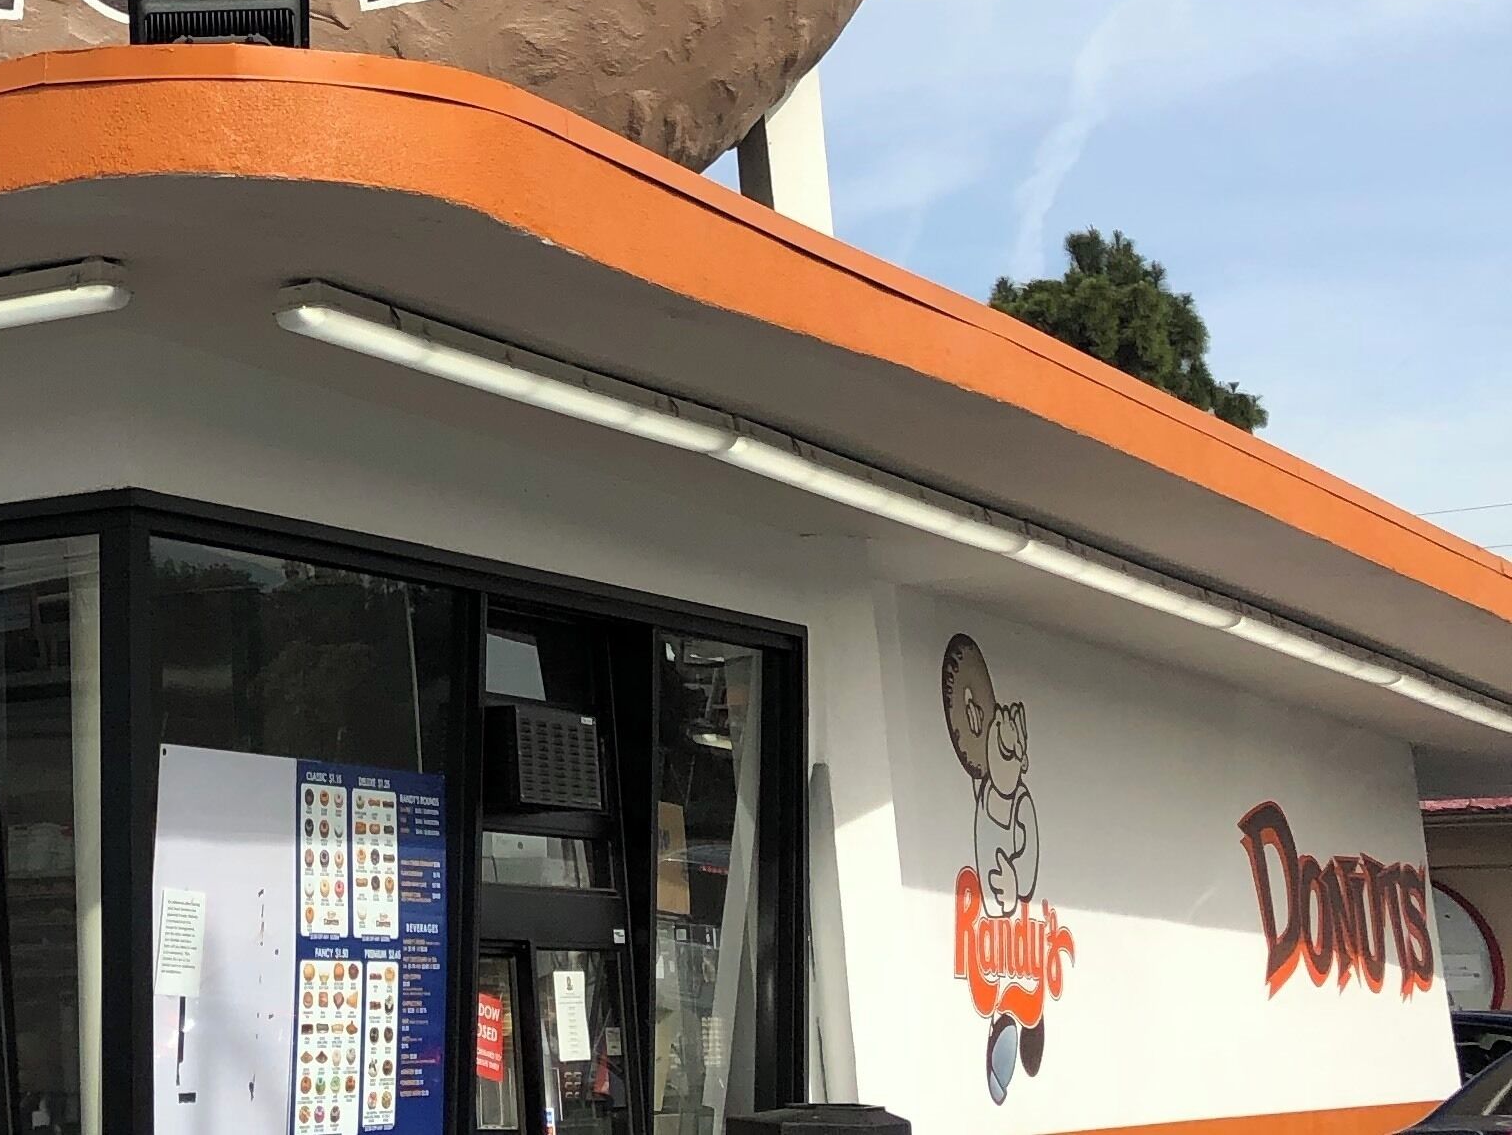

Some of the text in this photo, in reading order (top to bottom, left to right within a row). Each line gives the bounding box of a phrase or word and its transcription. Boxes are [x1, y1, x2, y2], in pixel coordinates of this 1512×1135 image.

[305, 771, 327, 783] CLASSIC
[954, 866, 1076, 1028] Randy's
[1237, 800, 1434, 1001] DONUTS
